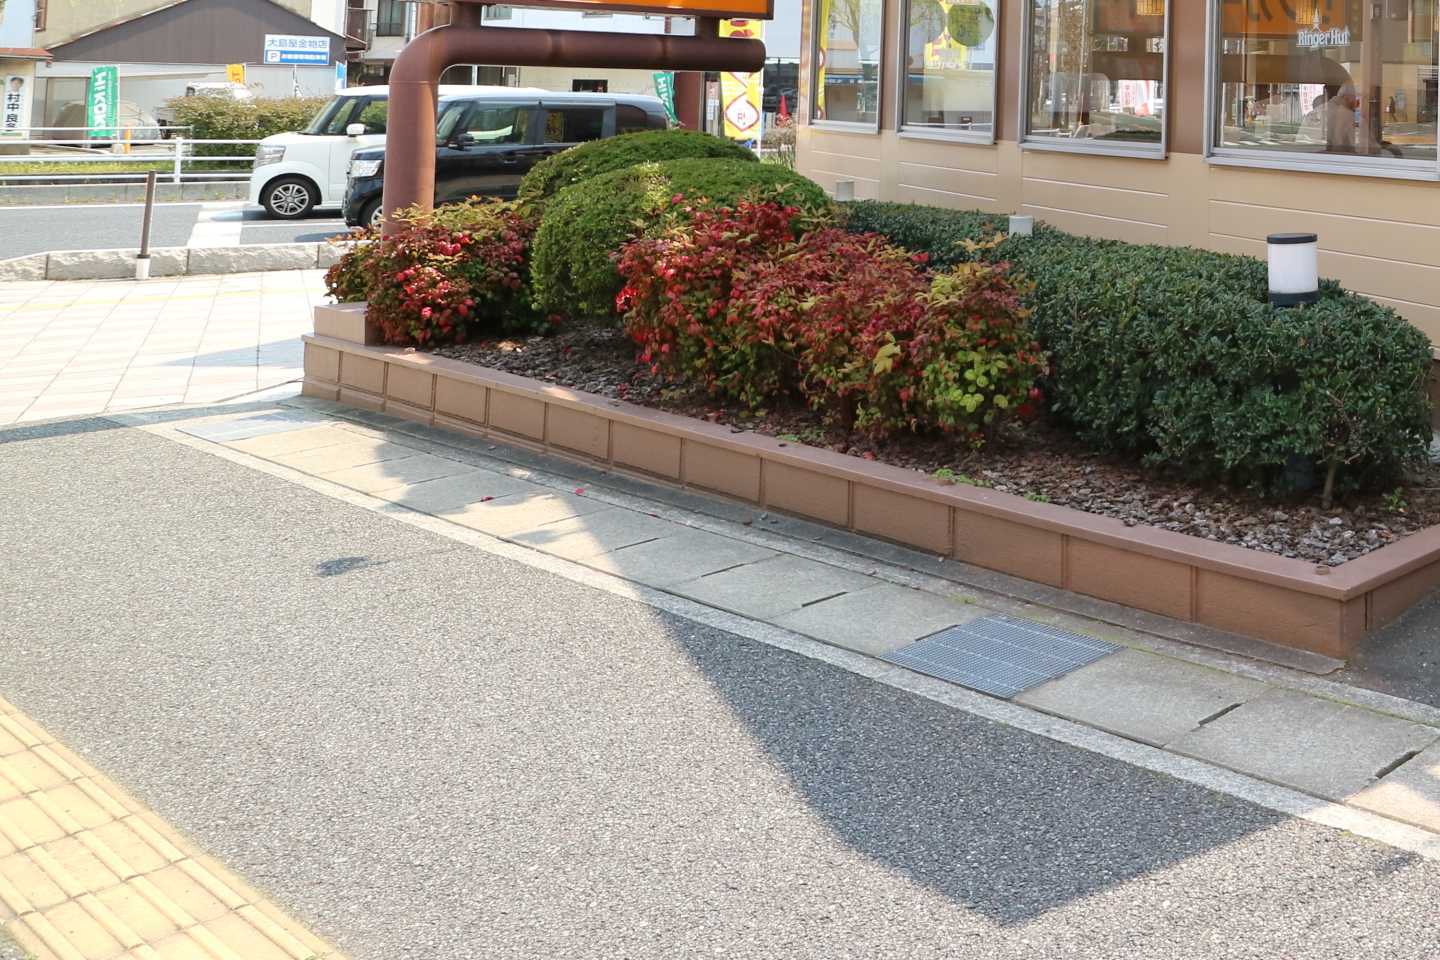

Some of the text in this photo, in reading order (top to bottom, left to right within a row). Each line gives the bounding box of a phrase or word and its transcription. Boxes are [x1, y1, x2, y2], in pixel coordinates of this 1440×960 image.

[268, 38, 328, 49] 大島屋金物店
[1298, 26, 1350, 49] Ringer Hut
